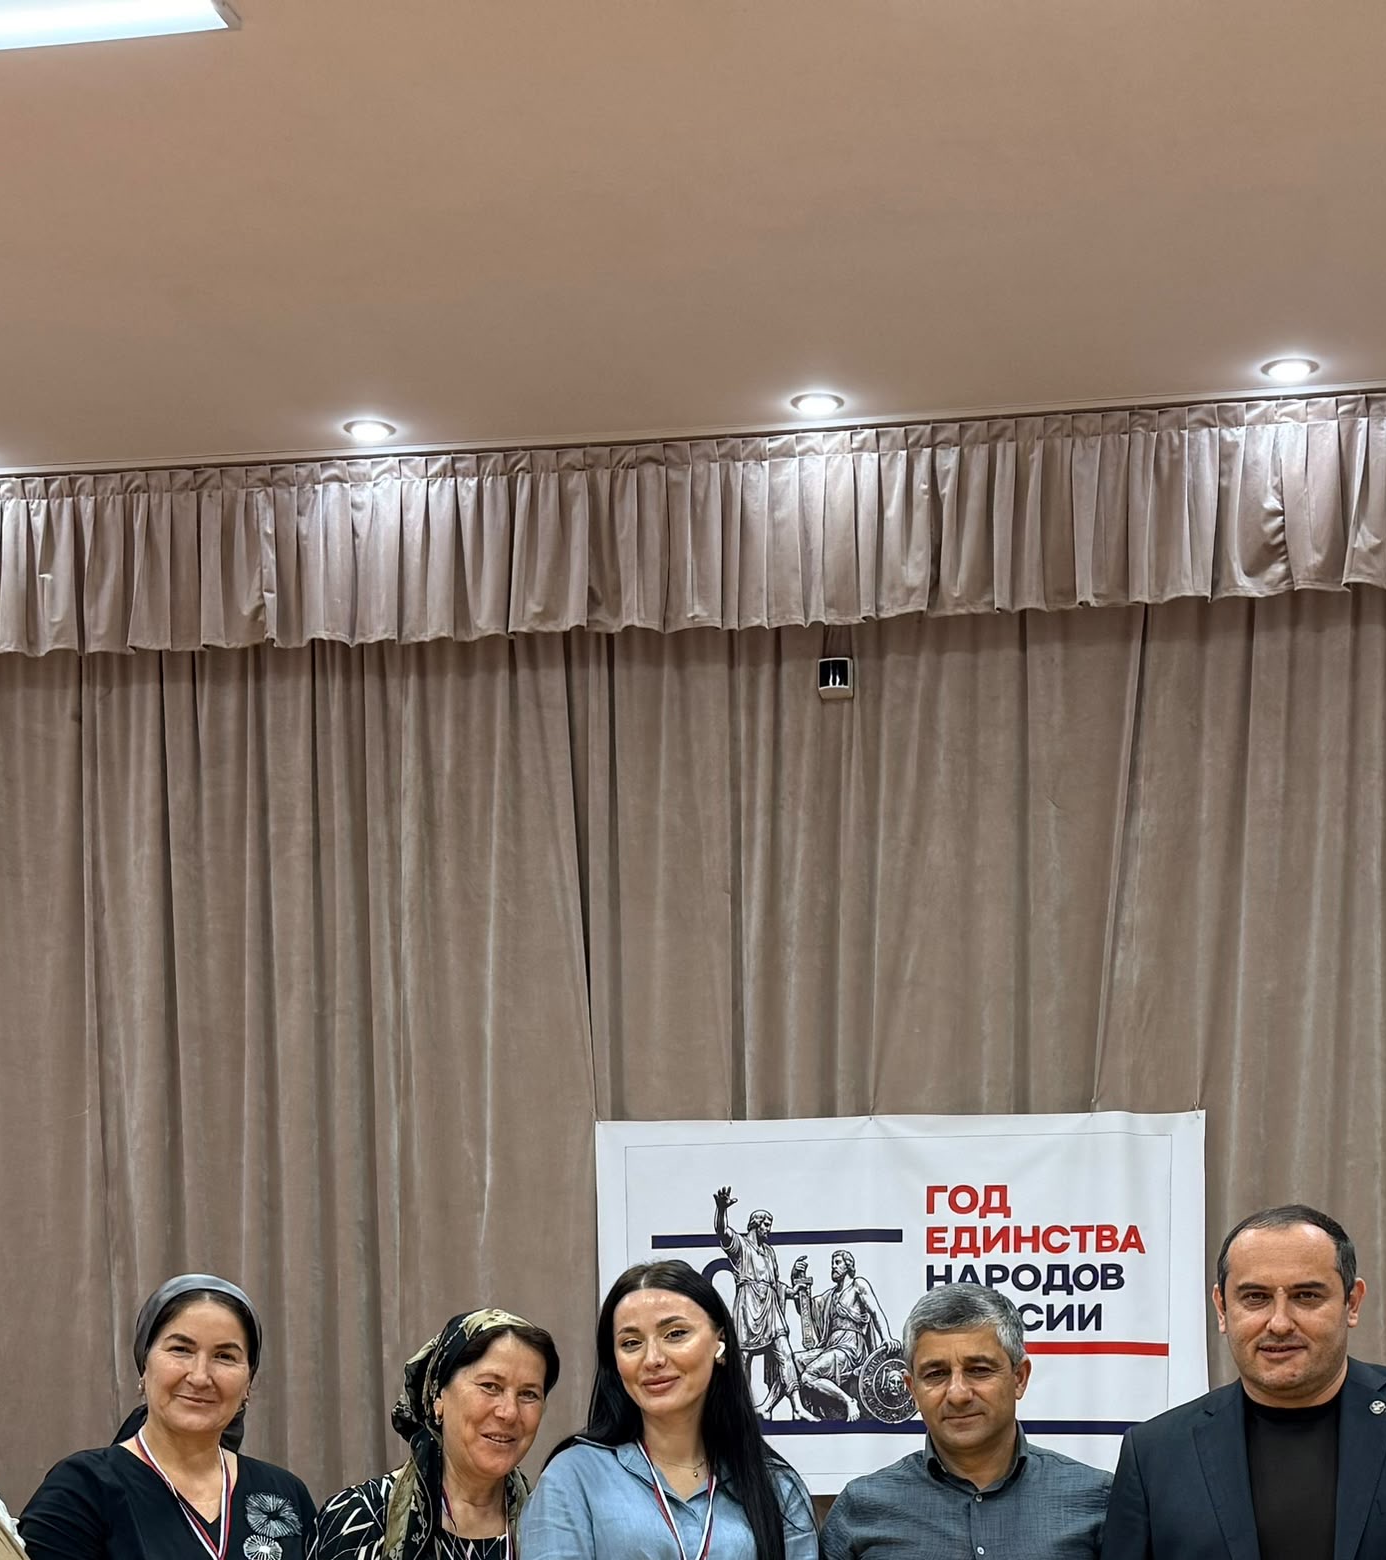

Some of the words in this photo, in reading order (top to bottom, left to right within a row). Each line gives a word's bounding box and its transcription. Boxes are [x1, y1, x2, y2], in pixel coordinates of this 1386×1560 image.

[925, 1184, 1012, 1219] ГОД
[925, 1224, 1146, 1259] ЕДИНСТВА
[925, 1263, 1125, 1296] НАРОДОВ
[1019, 1303, 1103, 1332] СИИ
